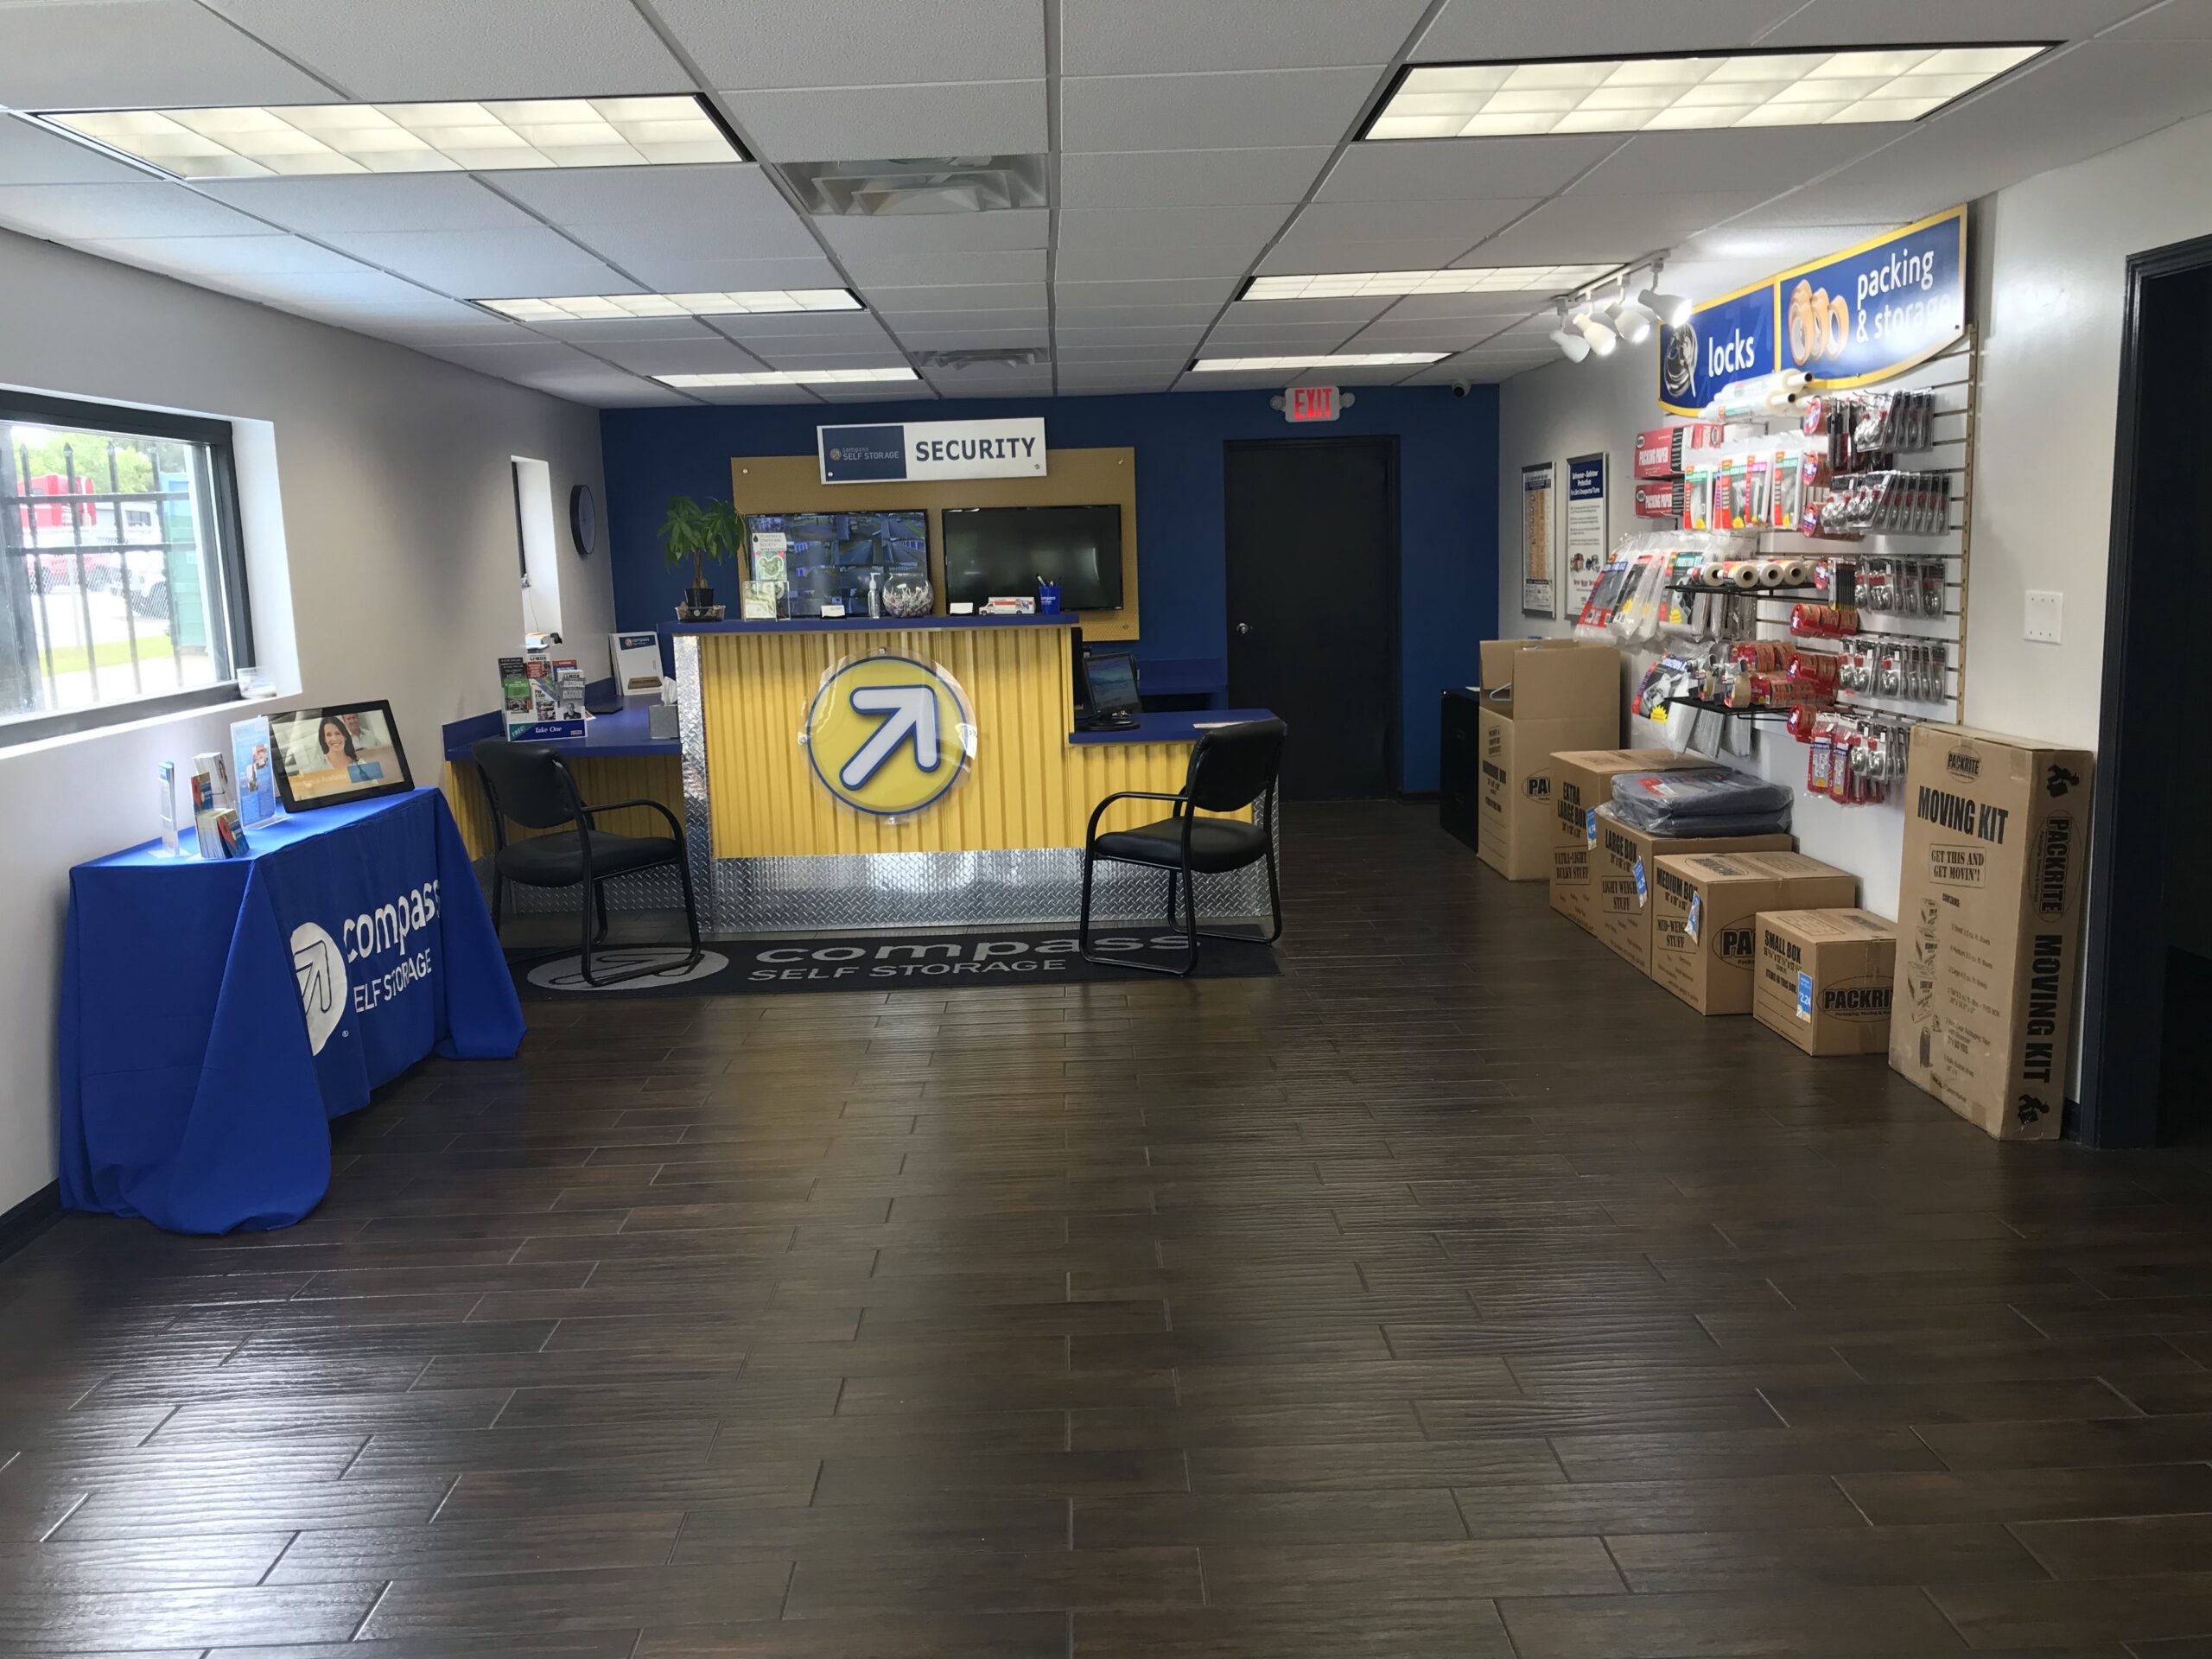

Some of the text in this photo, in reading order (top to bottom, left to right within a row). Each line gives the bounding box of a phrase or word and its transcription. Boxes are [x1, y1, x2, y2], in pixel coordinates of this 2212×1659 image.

[1858, 249, 1935, 311] packing
[1857, 293, 1951, 343] & storage
[1708, 328, 1754, 378] locks
[1294, 387, 1332, 420] EXIT
[842, 451, 899, 461] SELF STORAGE
[915, 437, 1036, 461] SECURITY
[1948, 753, 1980, 775] PACKRITE
[1563, 781, 1580, 807] EXTRA
[1558, 799, 1574, 823] LARGE
[1917, 785, 2009, 845] MOVING KIT
[1555, 851, 1587, 864] ULTRA-LIGHT
[1605, 829, 1624, 856] LARGE
[1624, 838, 1637, 863] BOX
[1931, 849, 1985, 867] GET THIS AND
[1556, 866, 1588, 880] BULKY STUFF
[1934, 866, 1980, 882] GET MOVIN'!
[2039, 817, 2070, 914] PACKRITE
[1602, 880, 1618, 894] LIGHT
[1619, 880, 1637, 895] WEIGH
[1656, 867, 1683, 897] MEDIUM
[1613, 897, 1630, 911] STUFF
[343, 879, 441, 963] compass
[1657, 918, 1686, 933] MID-WEIG
[755, 935, 1203, 963] compass
[1666, 934, 1685, 948] STUFF
[1764, 930, 1802, 963] SMALL BOX
[353, 948, 432, 1013] ELF STORAGE
[748, 958, 1066, 982] SELF STORAGE
[2023, 934, 2063, 1084] MOVING KIT
